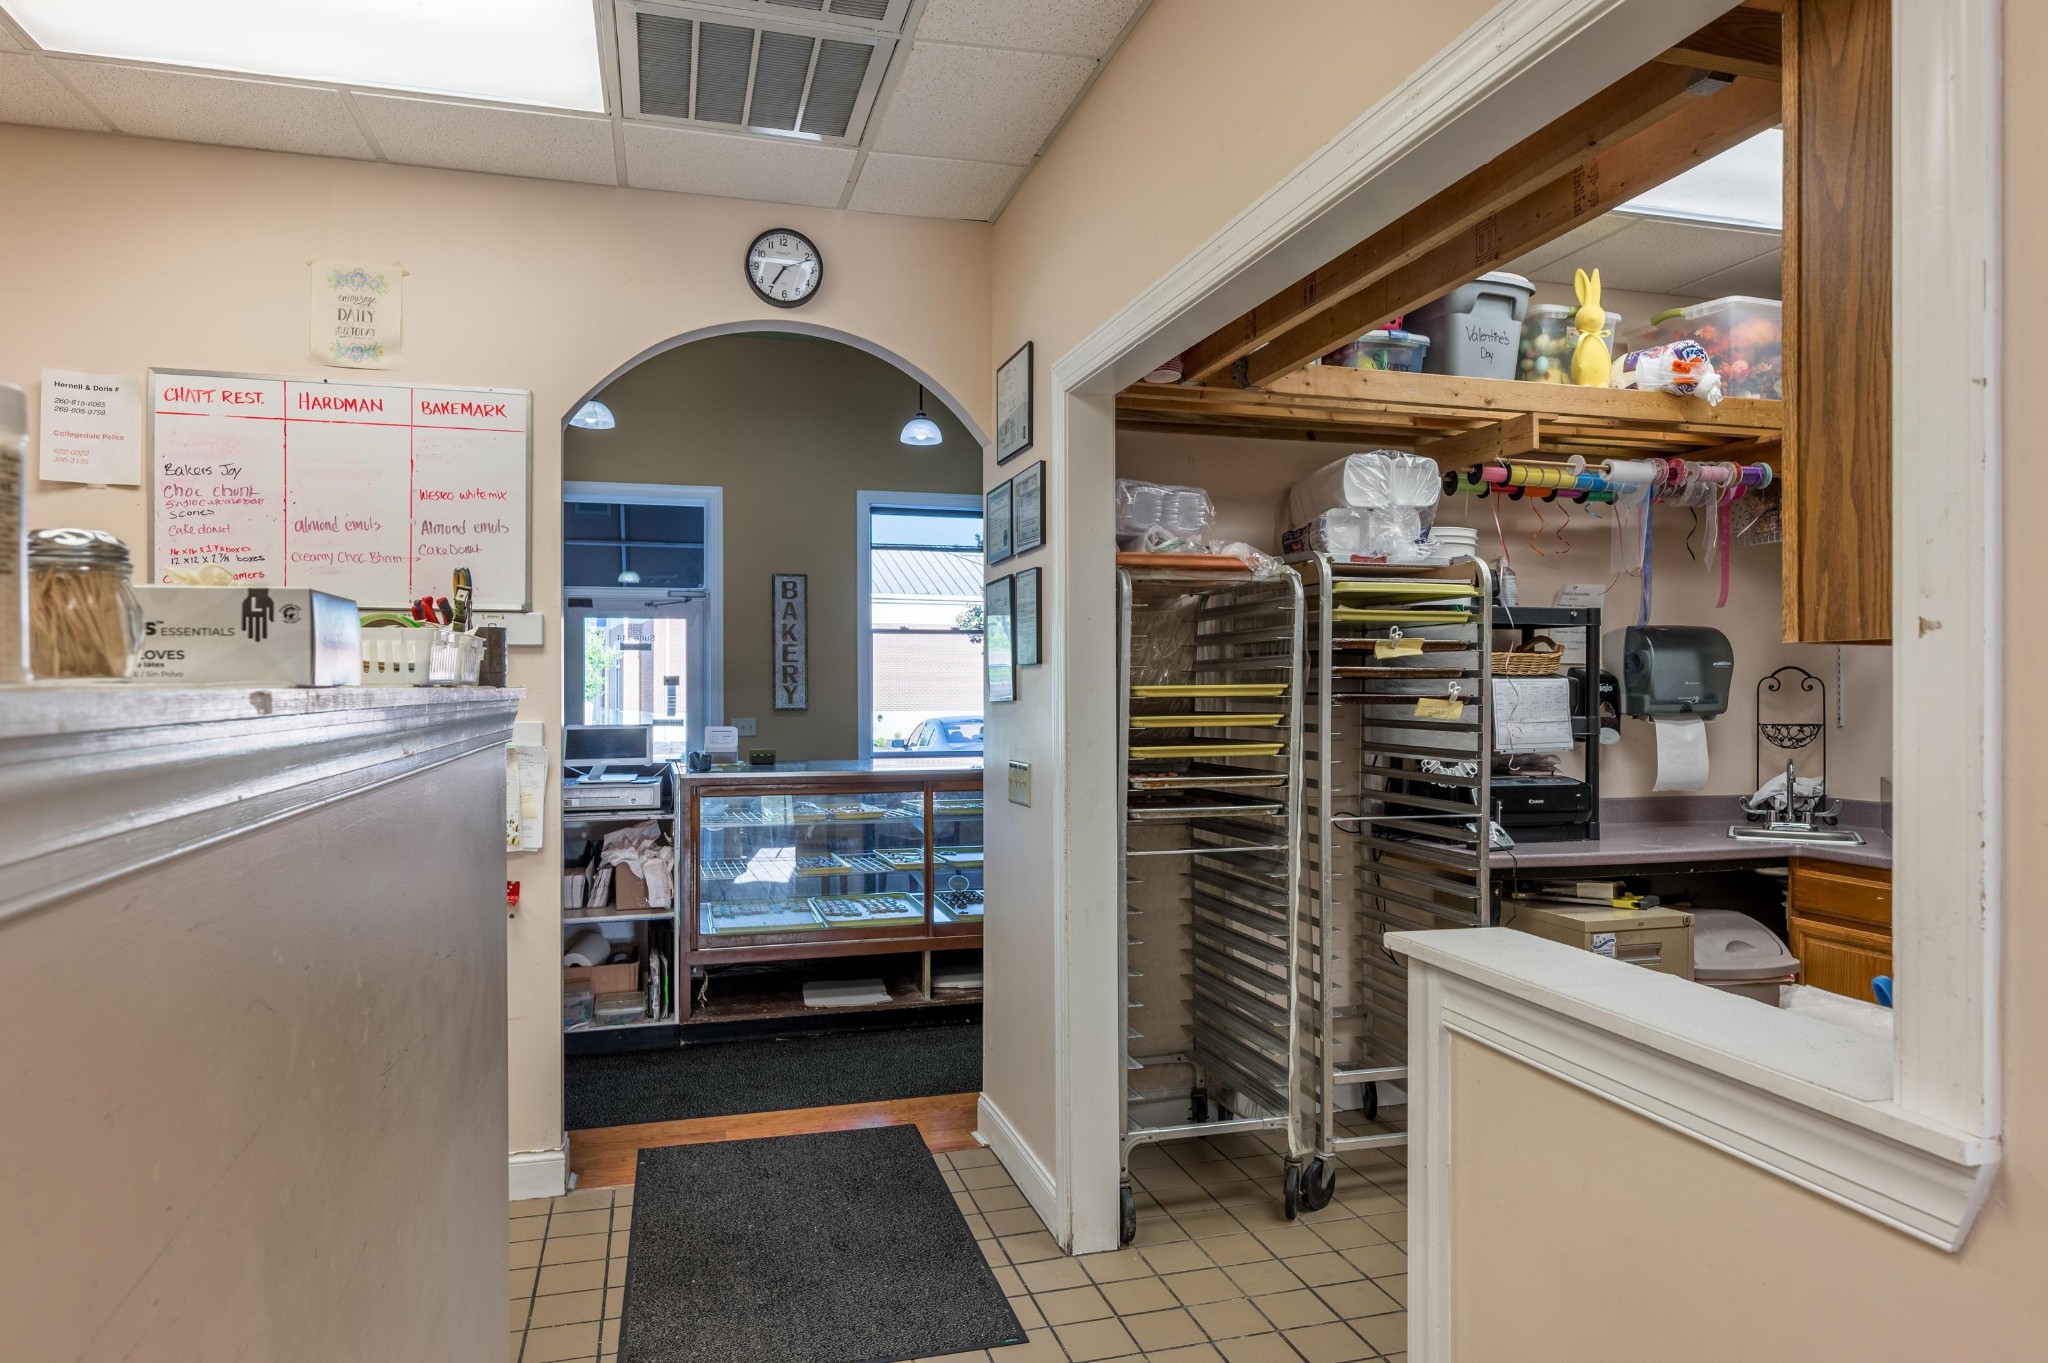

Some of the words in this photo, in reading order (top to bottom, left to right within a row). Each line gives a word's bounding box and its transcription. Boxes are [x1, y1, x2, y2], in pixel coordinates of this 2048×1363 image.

[768, 241, 774, 249] 11
[780, 238, 788, 247] 12
[758, 250, 765, 258] 10
[804, 253, 810, 261] 2
[754, 262, 759, 270] 9
[782, 290, 787, 299] 6
[795, 288, 800, 296] 5
[337, 294, 377, 306] encourage
[337, 308, 376, 323] DAILY
[350, 326, 377, 338] TODAY
[1465, 325, 1510, 345] Valentine's
[1481, 347, 1493, 364] Day
[54, 381, 83, 390] Hernell
[222, 391, 264, 404] REST.
[299, 392, 383, 413] HARDMAN
[421, 401, 507, 418] BAKEMARK
[53, 430, 100, 440] Collegedale
[102, 433, 124, 441] Police
[164, 463, 213, 476] Bakers
[219, 463, 242, 480] Joy
[459, 488, 486, 500] white
[488, 490, 507, 501] mix
[198, 523, 232, 534] donut
[421, 519, 466, 535] Almond
[236, 554, 266, 562] boxes
[291, 551, 334, 565] Creamy
[160, 627, 236, 637] ESSENTIALS
[781, 580, 799, 704] BAKERY
